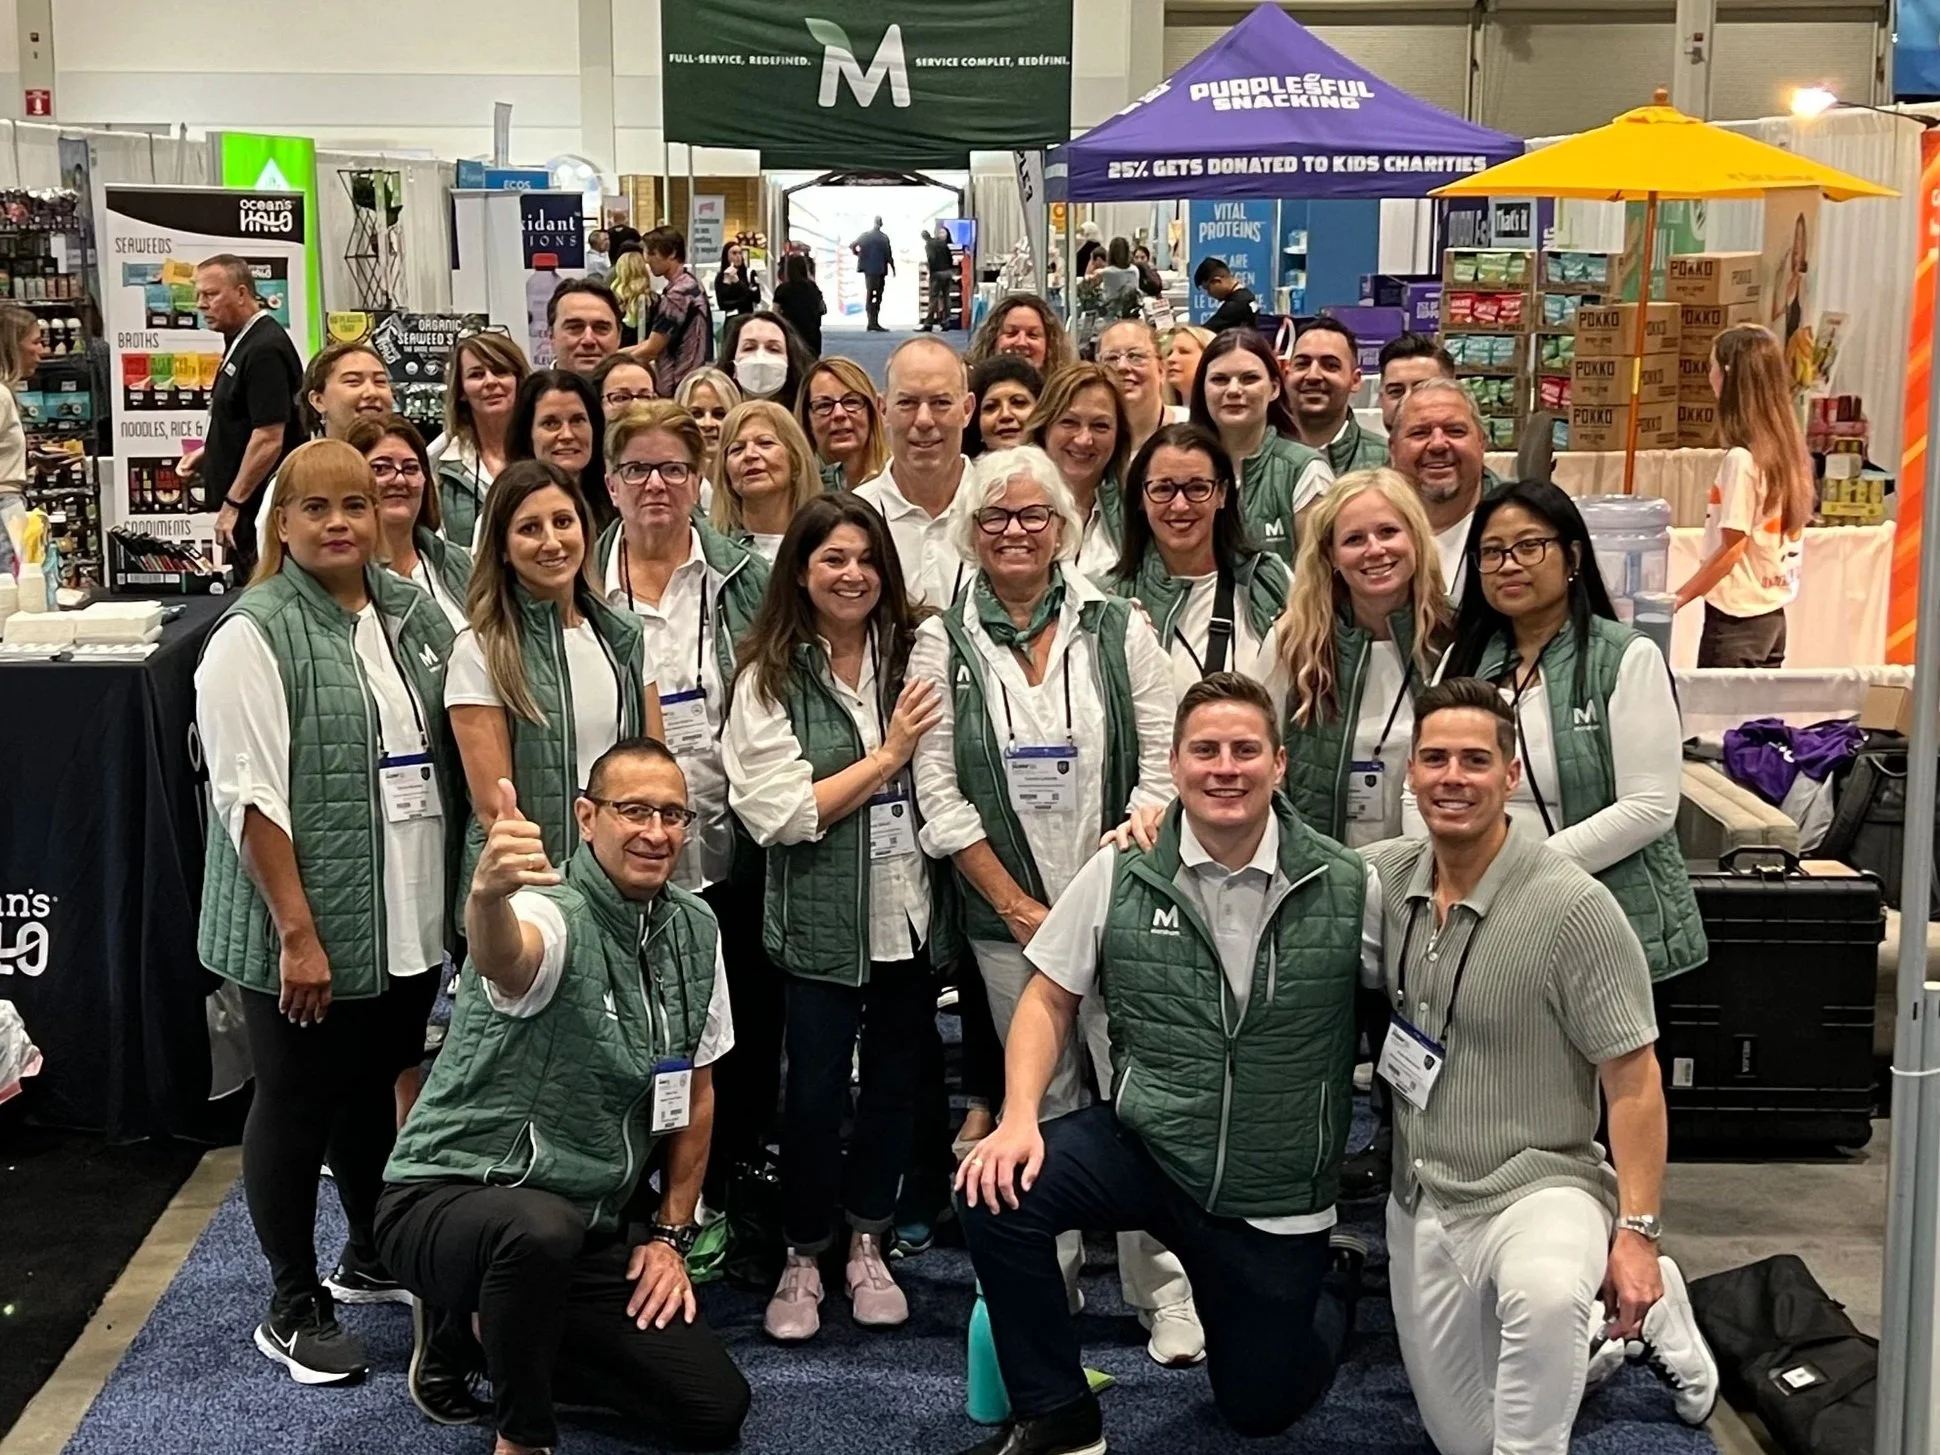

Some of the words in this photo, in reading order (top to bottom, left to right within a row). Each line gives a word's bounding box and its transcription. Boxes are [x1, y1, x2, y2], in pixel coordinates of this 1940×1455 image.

[669, 54, 746, 65] FULL-SERVICE,
[749, 56, 811, 66] REDEFINED.
[915, 57, 958, 67] SERVICE
[961, 57, 1014, 67] COMPLET,
[1017, 54, 1070, 66] REDÉFINI.
[1212, 95, 1360, 111] SNACKING
[1108, 160, 1149, 179] 25%
[1152, 158, 1204, 177] GETS
[1207, 156, 1298, 175] DONATED
[1302, 156, 1329, 173] TO
[1332, 156, 1380, 173] KIDS
[1384, 156, 1487, 172] CHARITIES
[503, 180, 531, 189] ECOS
[1214, 203, 1247, 220] VITAL
[1199, 221, 1261, 243] PROTEINS
[115, 237, 172, 254] SEAWEEDS
[1229, 253, 1248, 268] ARE
[1670, 260, 1713, 277] POKKO
[418, 319, 462, 332] ORGANIC
[1579, 311, 1620, 328] POKKO
[117, 333, 159, 349] BROTHS
[397, 332, 444, 345] SEAWEED
[1575, 360, 1616, 378] POKKO
[1573, 408, 1613, 425] POKKO
[121, 421, 168, 440] NOODLES,
[170, 421, 192, 438] RICE
[1573, 699, 1598, 724] M
[1152, 904, 1179, 928] M
